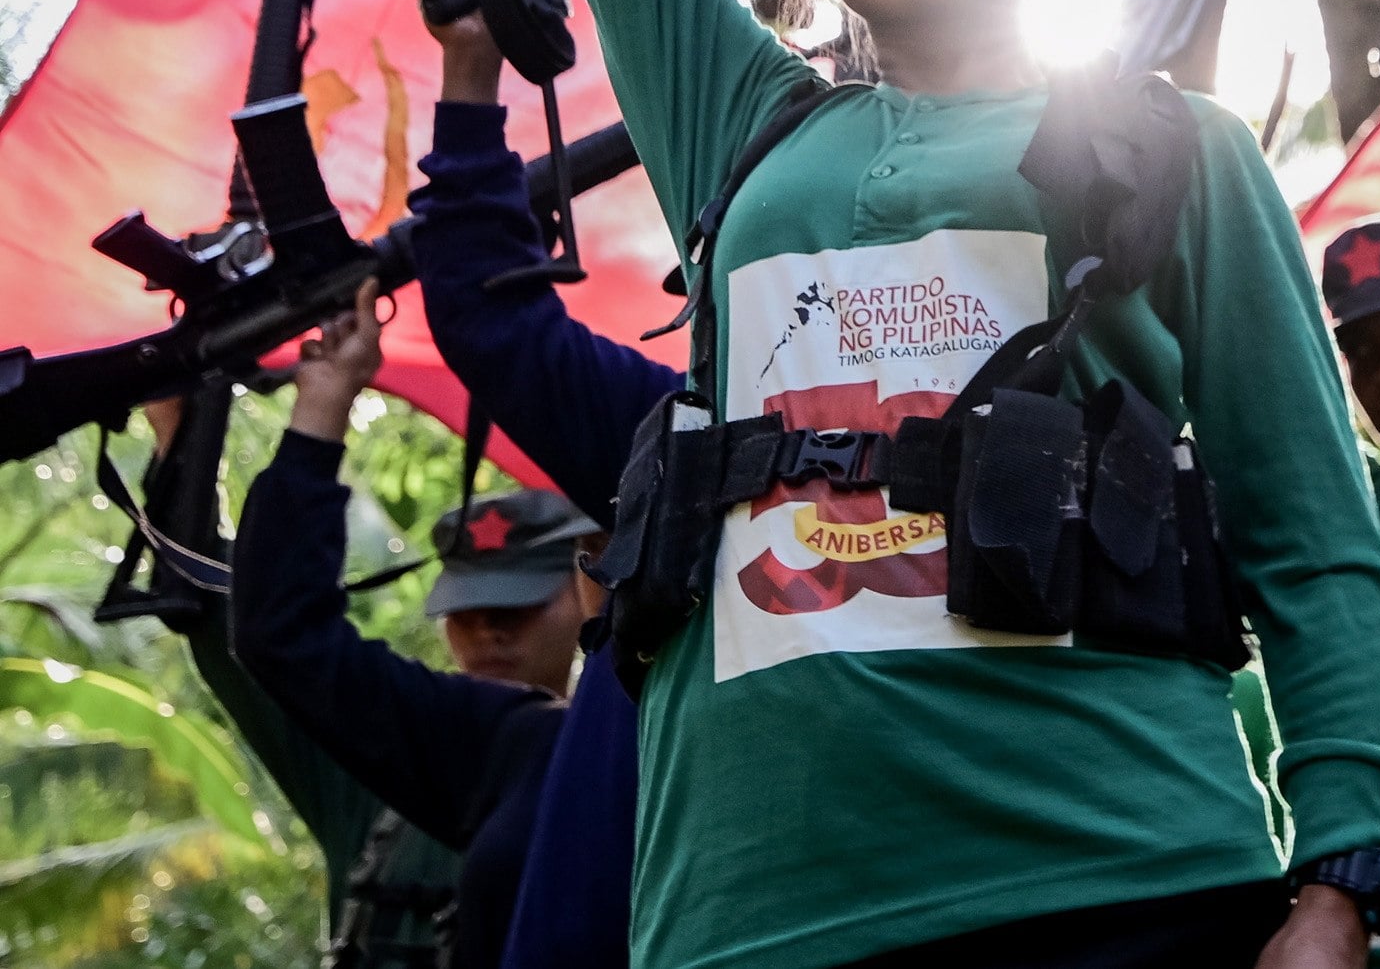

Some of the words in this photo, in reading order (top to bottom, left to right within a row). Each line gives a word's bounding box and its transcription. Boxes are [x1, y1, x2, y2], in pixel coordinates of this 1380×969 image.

[837, 276, 945, 310] PARTIDO
[840, 294, 988, 332] KOMUNISTA
[838, 347, 886, 367] TIMOG
[890, 338, 1004, 358] KATAGALUGAN
[839, 328, 873, 353] NG
[883, 317, 1002, 345] PILIPINAS
